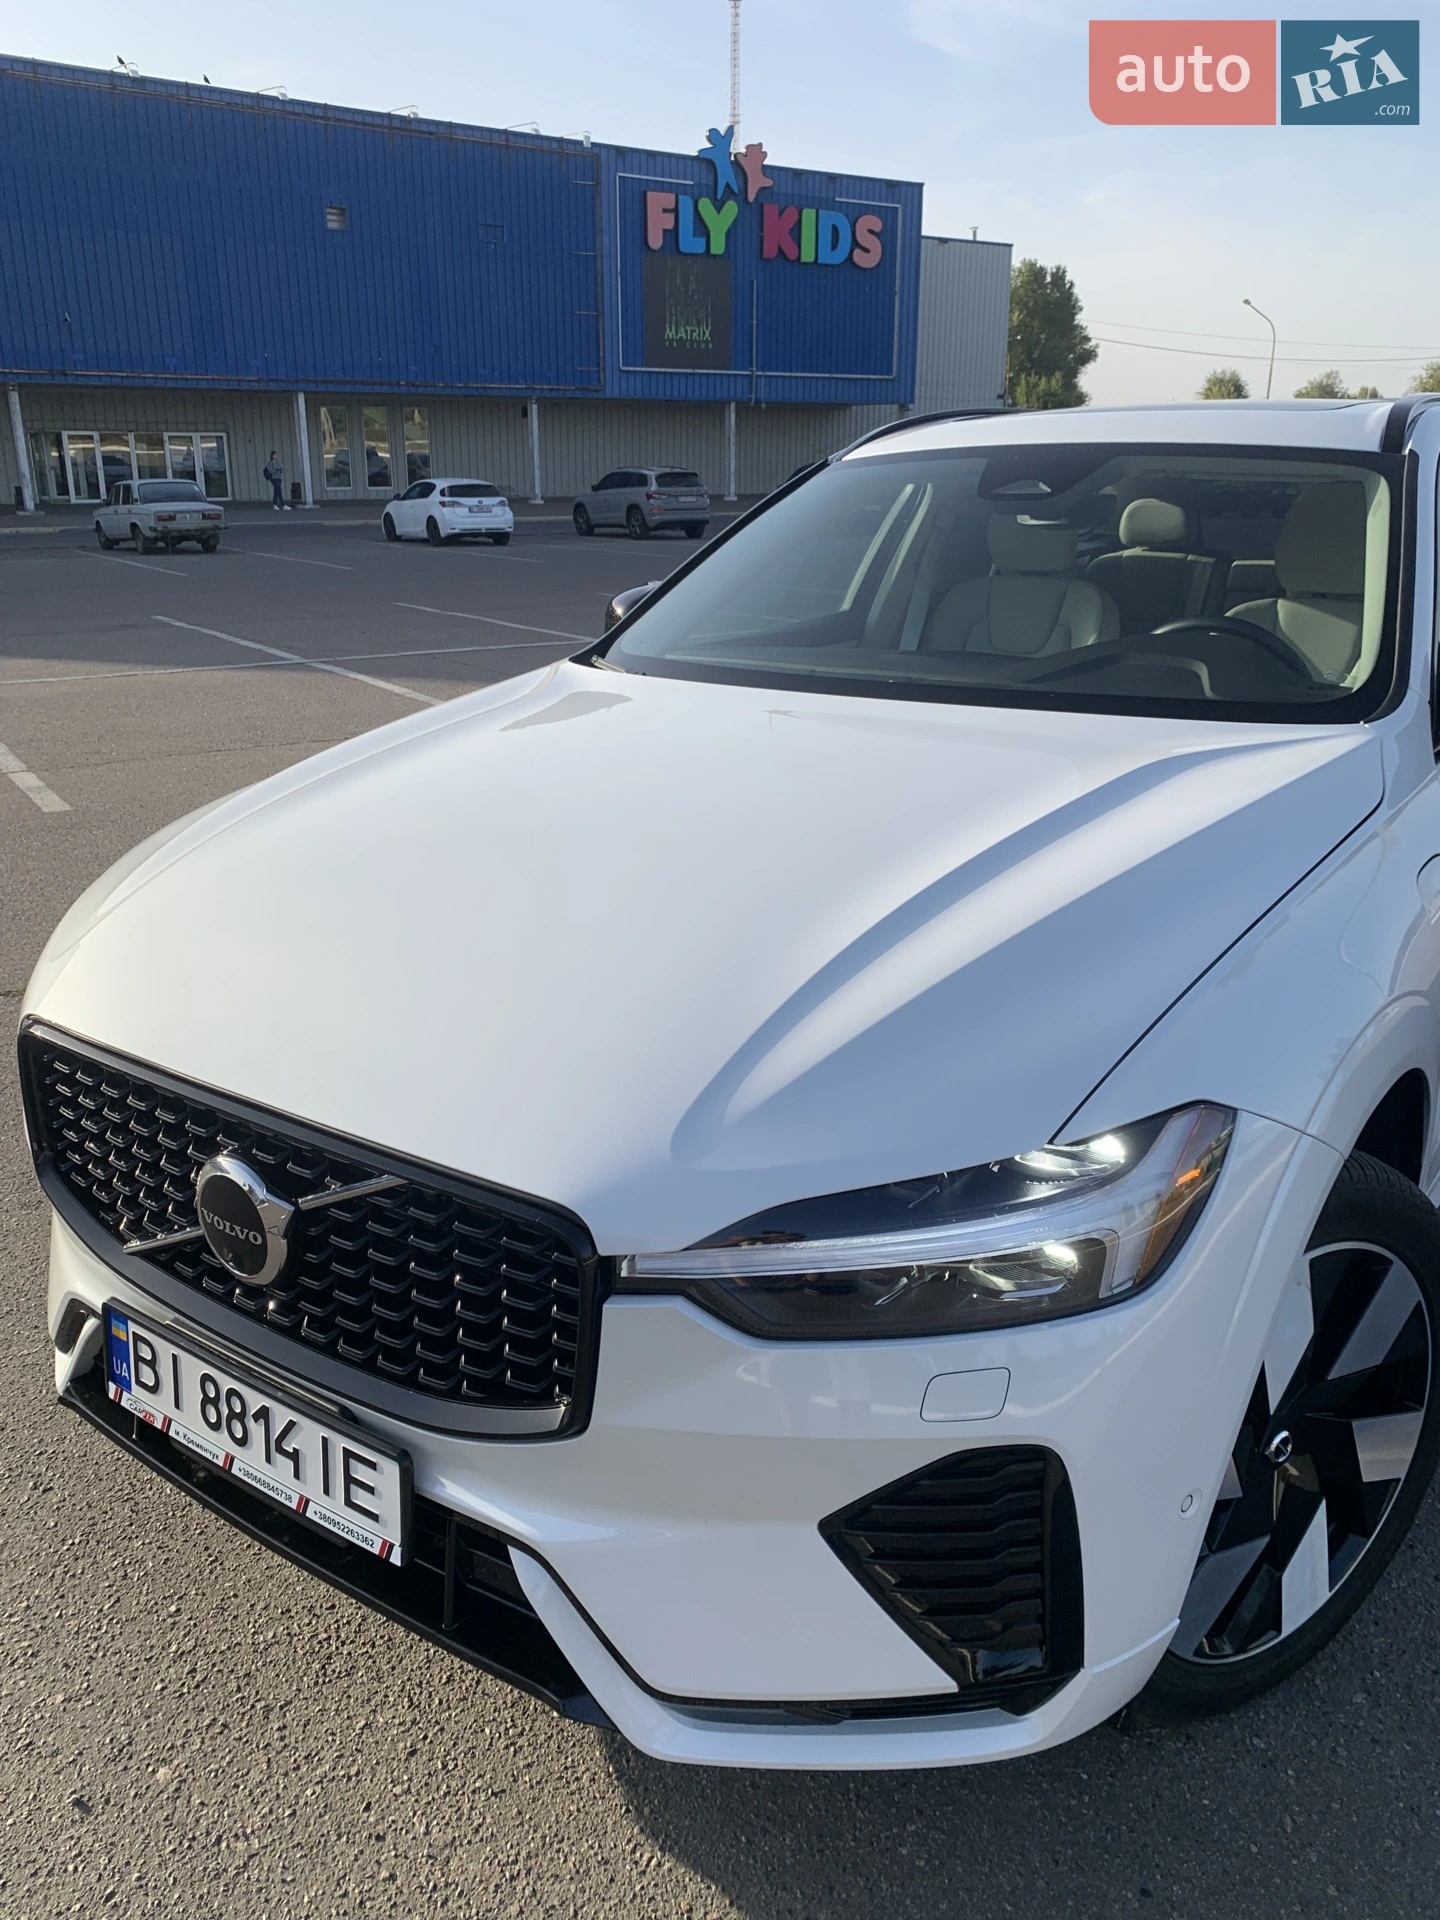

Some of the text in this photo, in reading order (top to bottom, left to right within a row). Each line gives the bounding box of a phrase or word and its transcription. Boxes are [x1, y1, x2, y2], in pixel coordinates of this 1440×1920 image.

[645, 190, 883, 269] FLY KIDS
[665, 325, 711, 340] MATRIX
[201, 1207, 262, 1245] VOLVO
[113, 1356, 130, 1381] UA
[131, 1330, 380, 1524] BI 8814 IE
[183, 1432, 220, 1461] Кременчук
[238, 1466, 293, 1503] +380668845738
[313, 1509, 375, 1549] +380952263362
